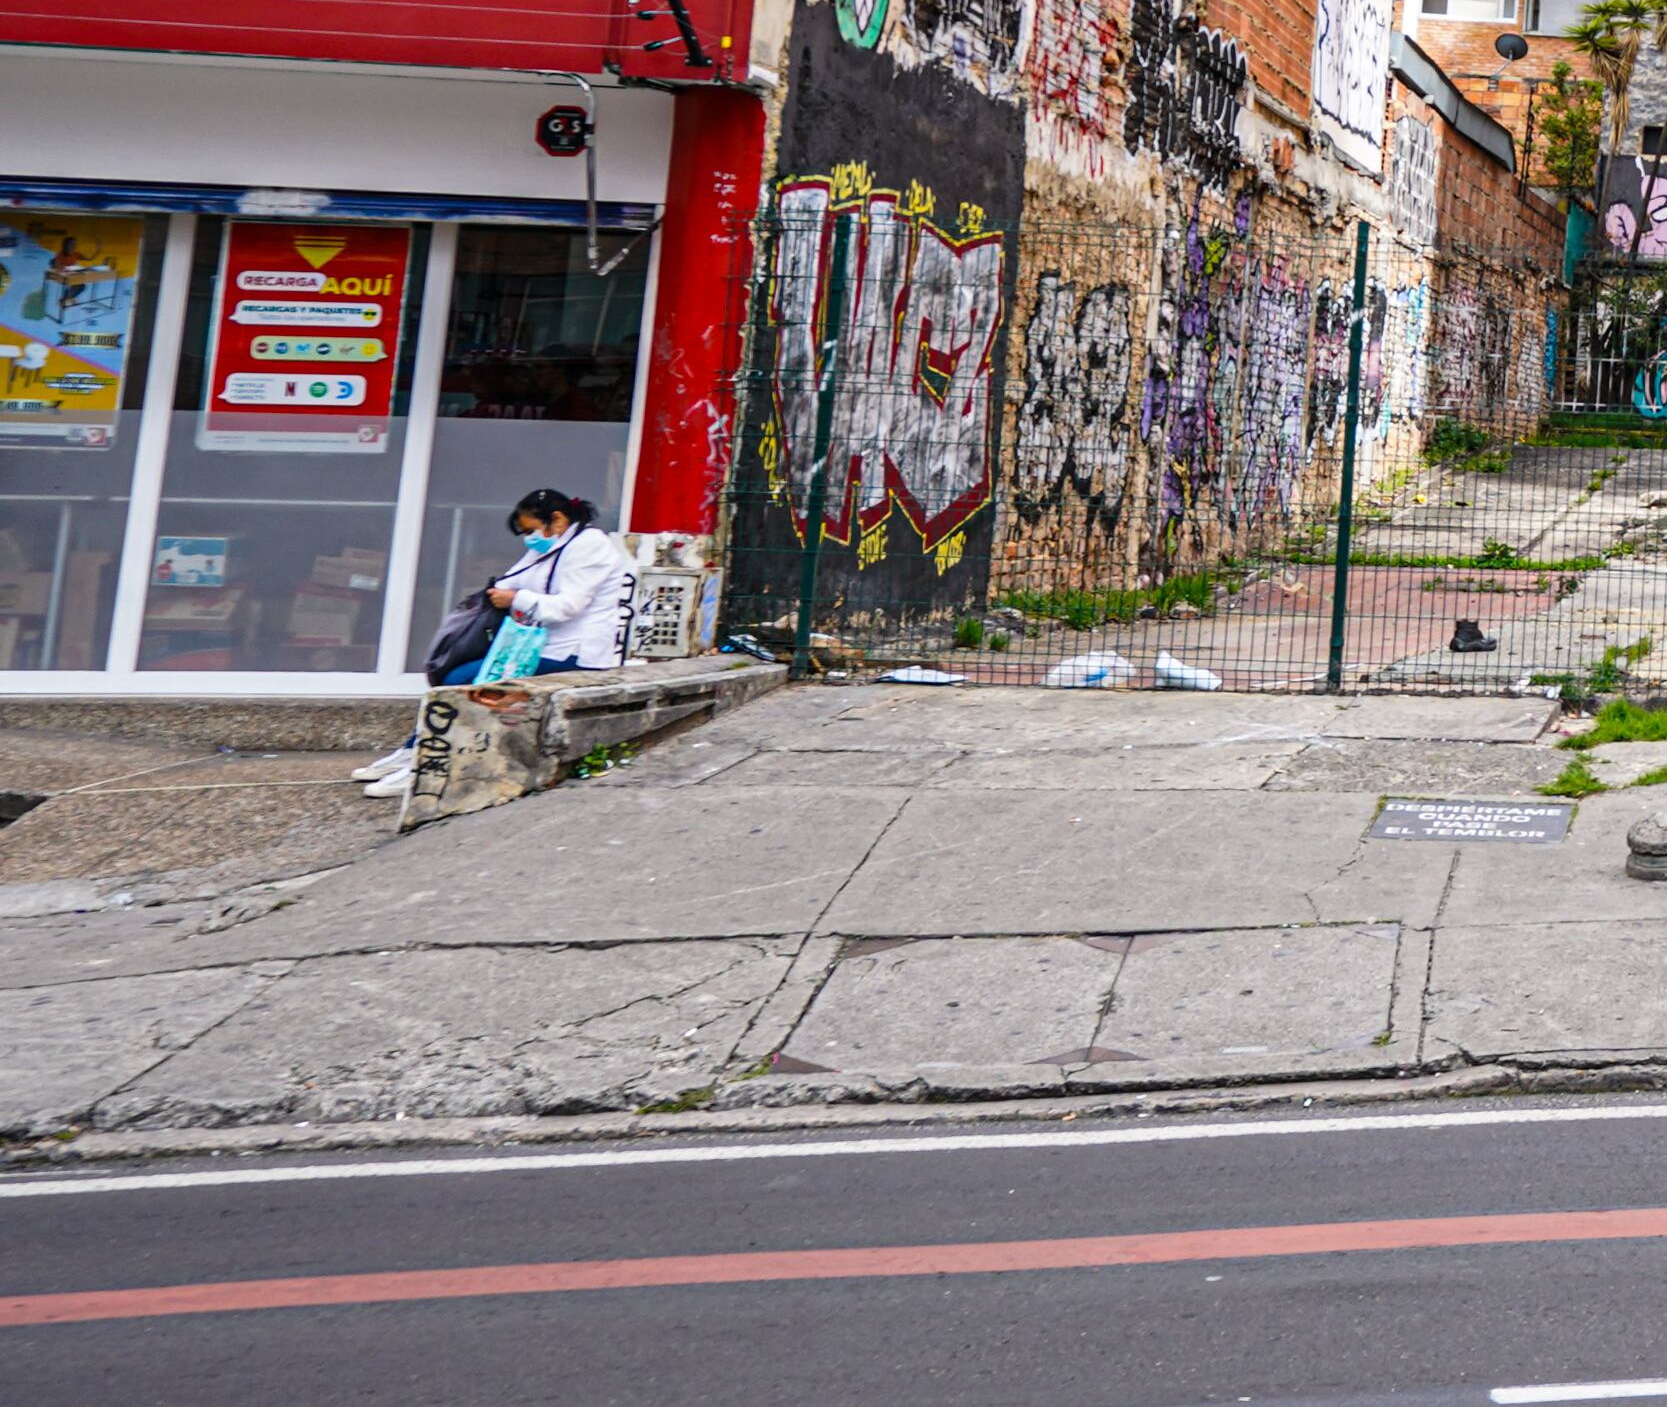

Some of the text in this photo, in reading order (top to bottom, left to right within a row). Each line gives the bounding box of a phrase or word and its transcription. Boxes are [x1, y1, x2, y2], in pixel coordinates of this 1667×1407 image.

[243, 276, 318, 287] RECARGA
[319, 274, 394, 296] AQUÍ
[1386, 803, 1562, 817] DESPIÉRTAME
[1418, 812, 1531, 824] CUANDO
[1433, 820, 1498, 830] PASE
[1384, 827, 1546, 839] EL TEMBLOR
